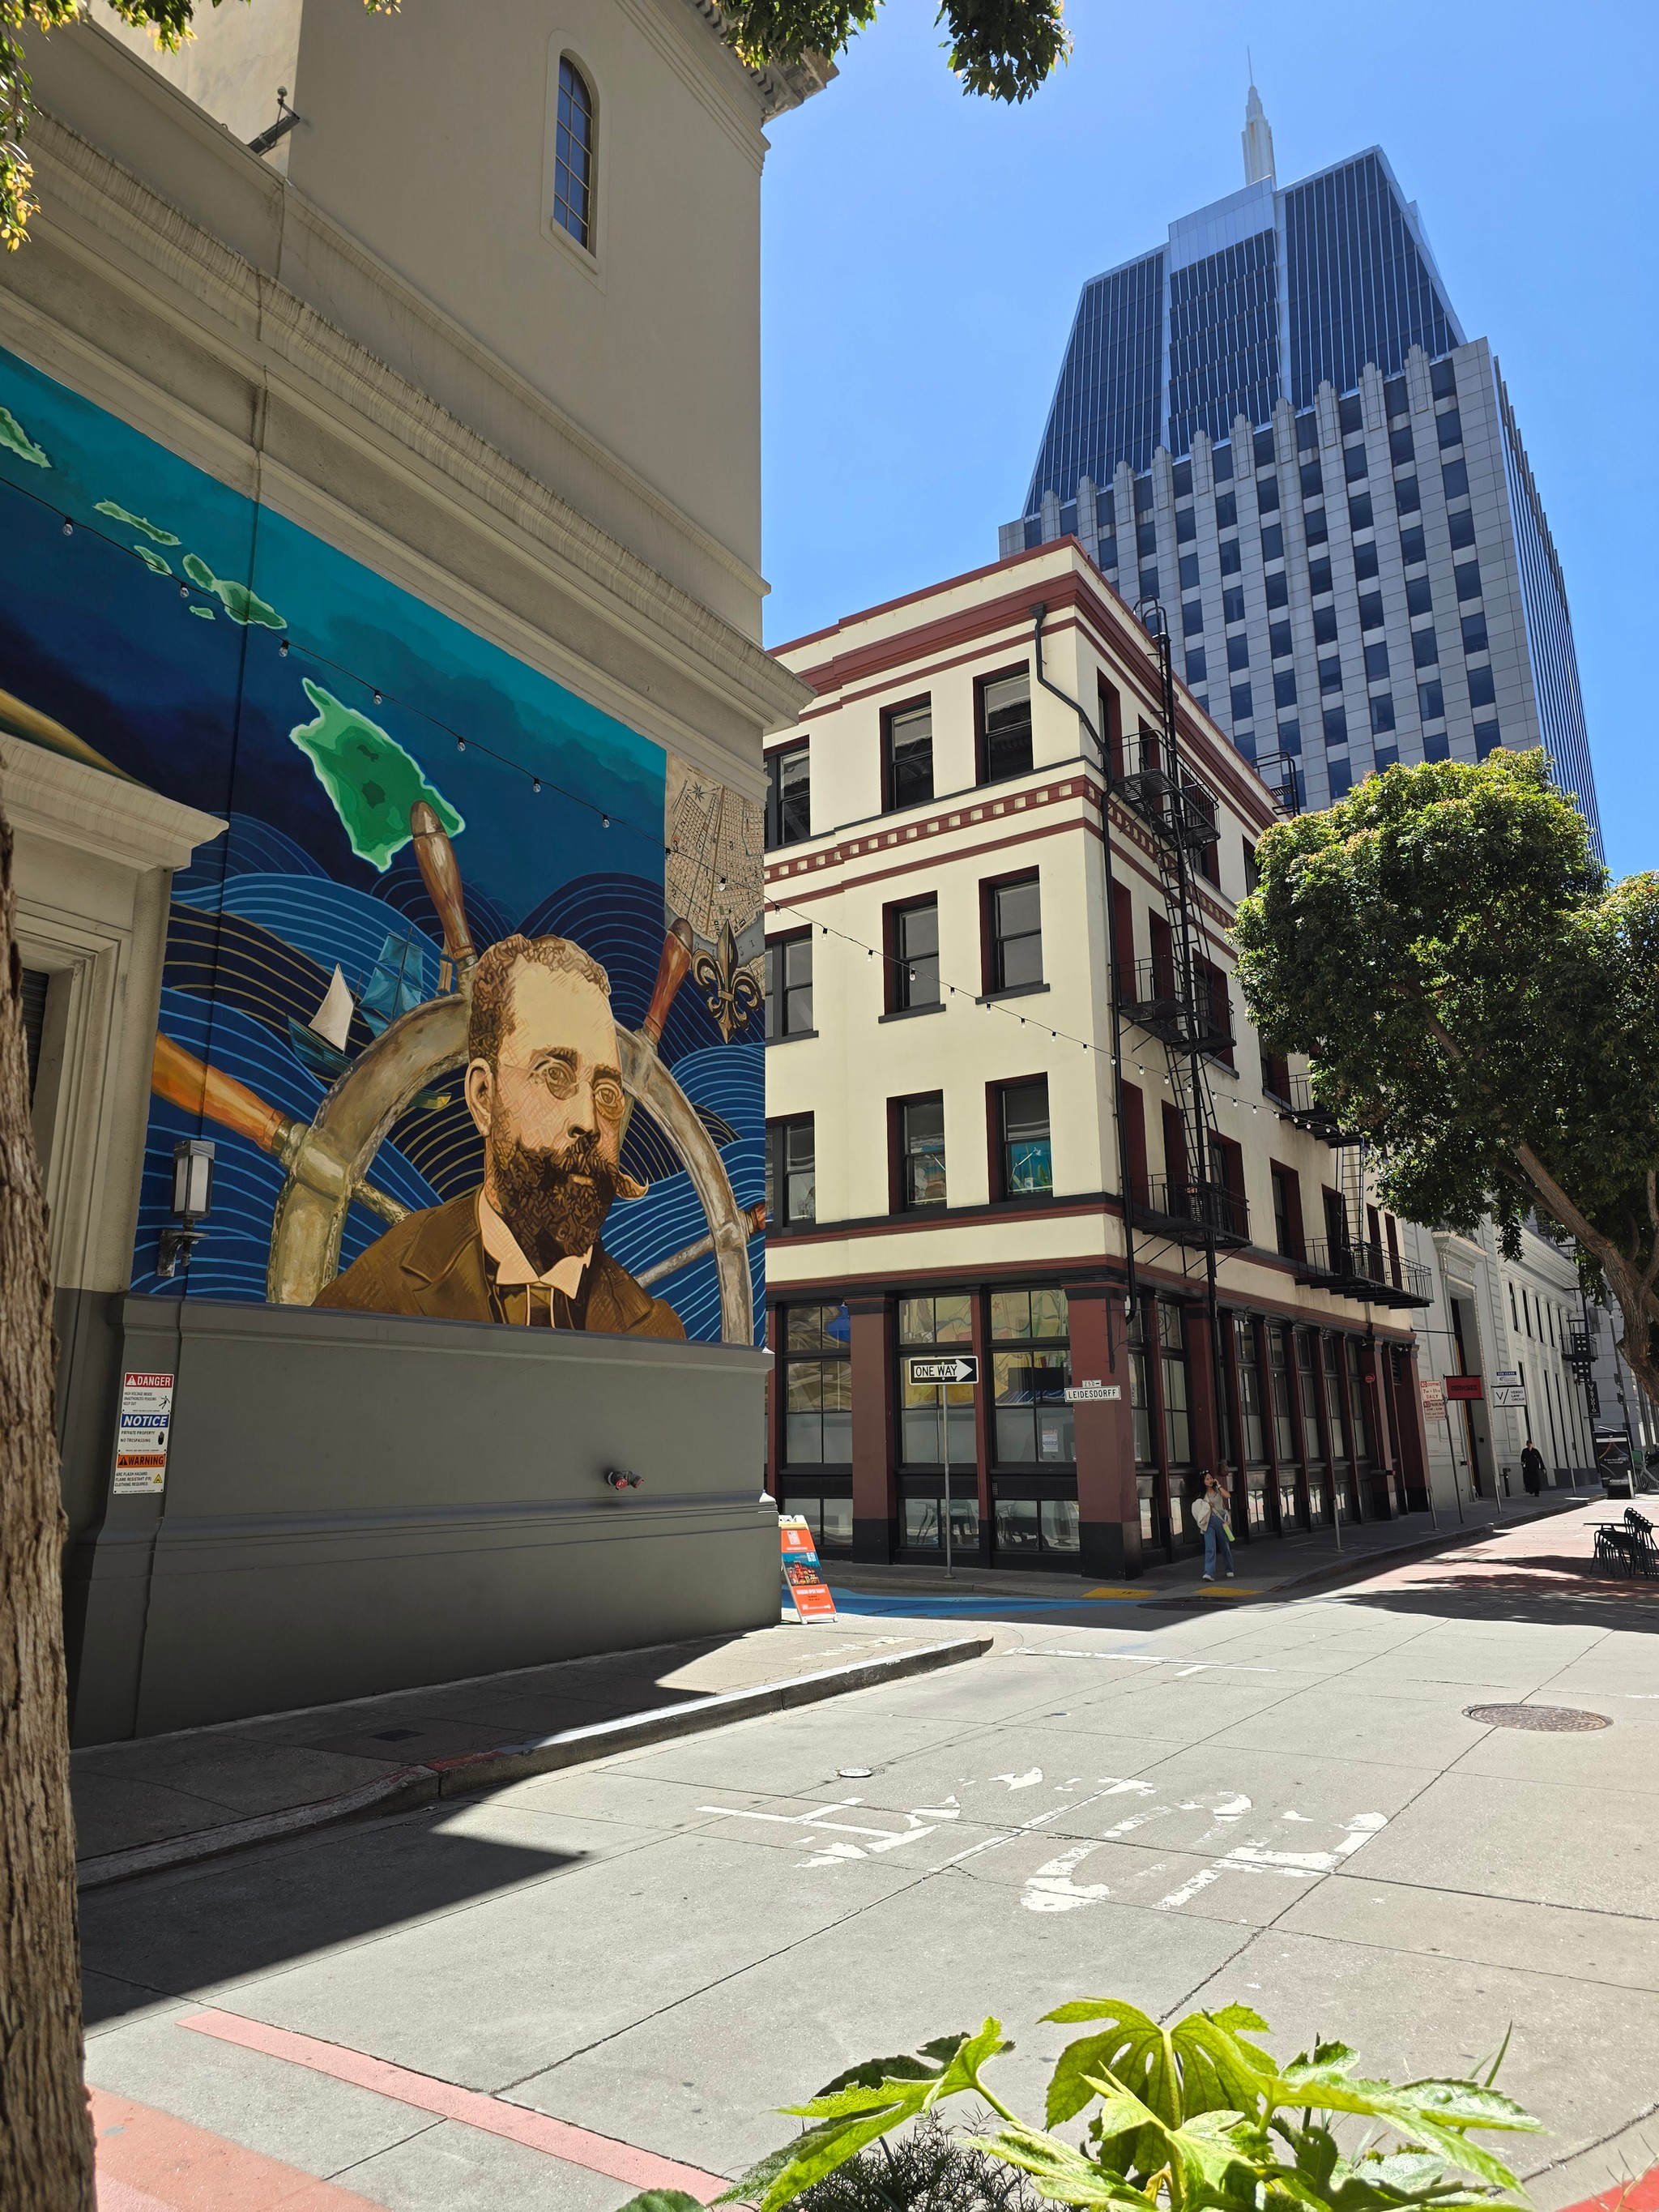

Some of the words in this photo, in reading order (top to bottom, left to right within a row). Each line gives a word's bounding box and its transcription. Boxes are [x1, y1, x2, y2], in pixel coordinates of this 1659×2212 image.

[915, 1365, 935, 1377] ONE
[938, 1364, 957, 1376] WAY
[138, 1376, 171, 1386] DANGER
[1068, 1389, 1117, 1399] LEIDESDORFF
[123, 1416, 168, 1426] NOTICE
[129, 1456, 164, 1465] WARNING
